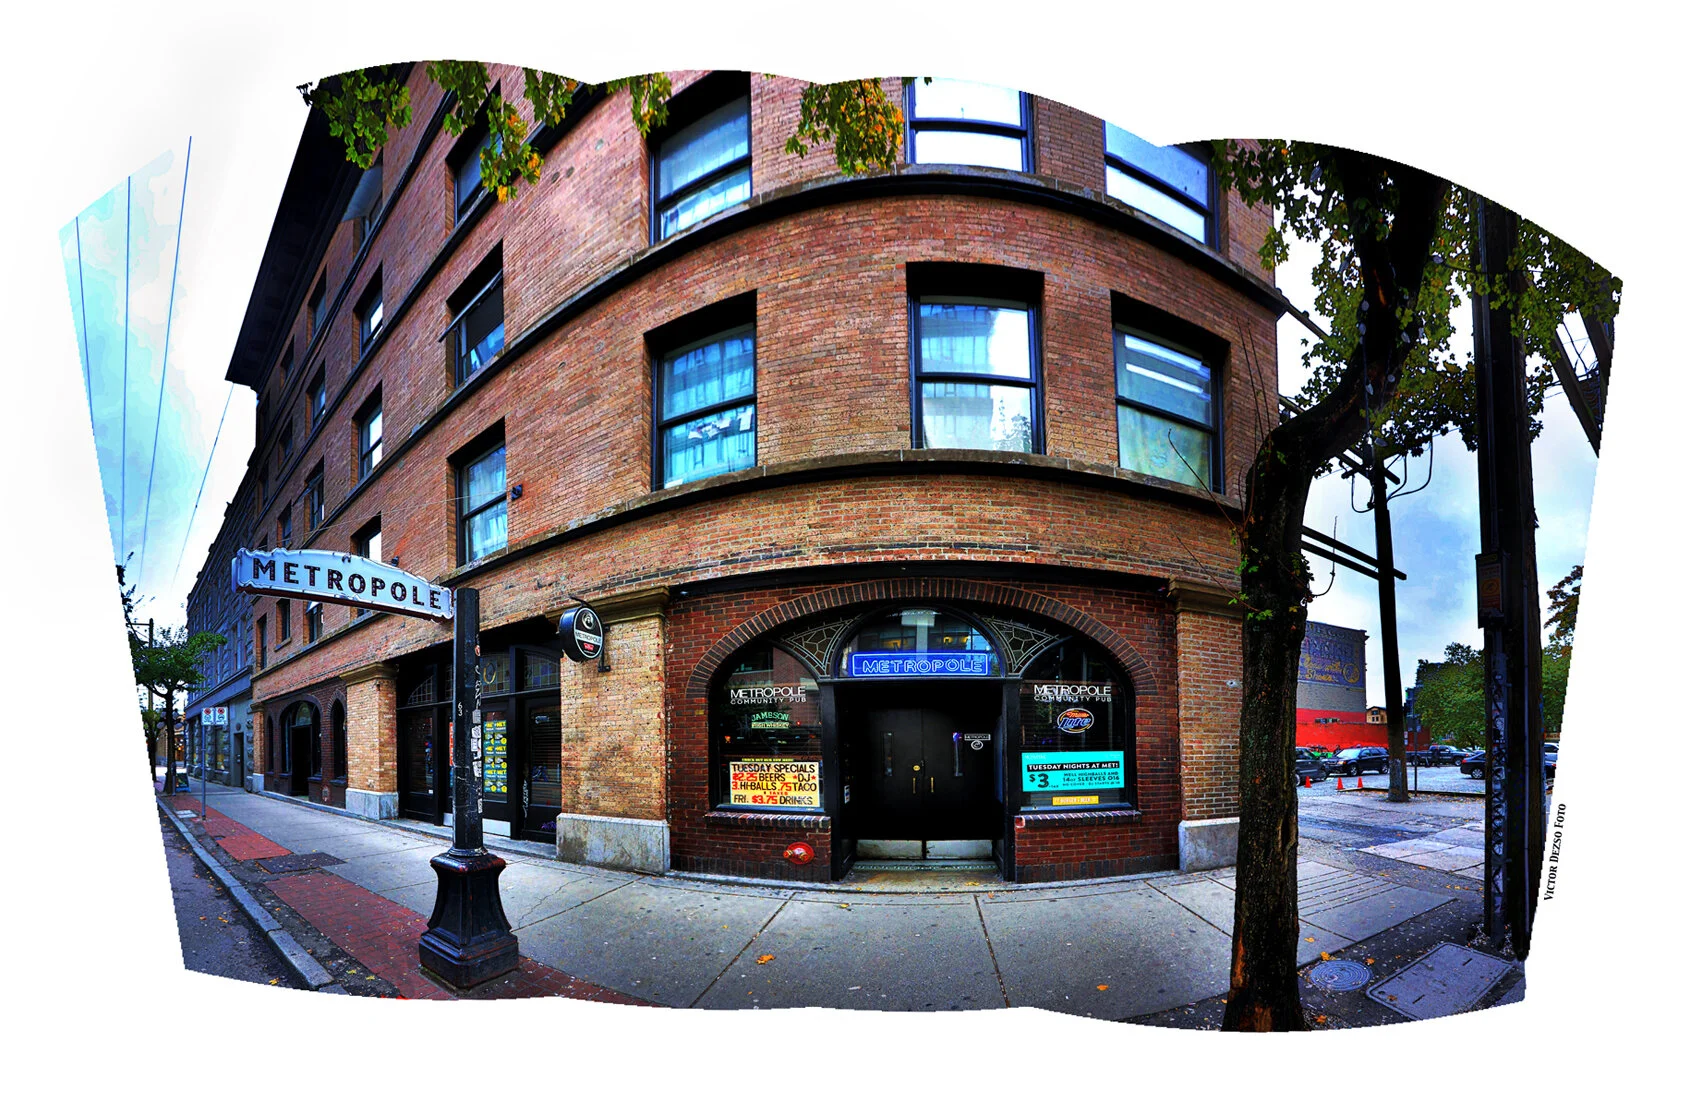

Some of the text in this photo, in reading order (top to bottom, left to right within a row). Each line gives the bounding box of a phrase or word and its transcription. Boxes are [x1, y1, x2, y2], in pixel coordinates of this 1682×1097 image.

[252, 557, 442, 610] METROPOLE
[862, 658, 983, 673] METROPOLE
[730, 685, 806, 699] METROPOLE
[1034, 684, 1112, 696] METROPOLE
[730, 697, 784, 705] COMMUNITY
[751, 711, 790, 722] JAMESON
[733, 763, 815, 773] TUESDAY SPECIALS
[758, 773, 786, 782] BEERS
[733, 794, 813, 805] FRI. $3.75 DRINKS
